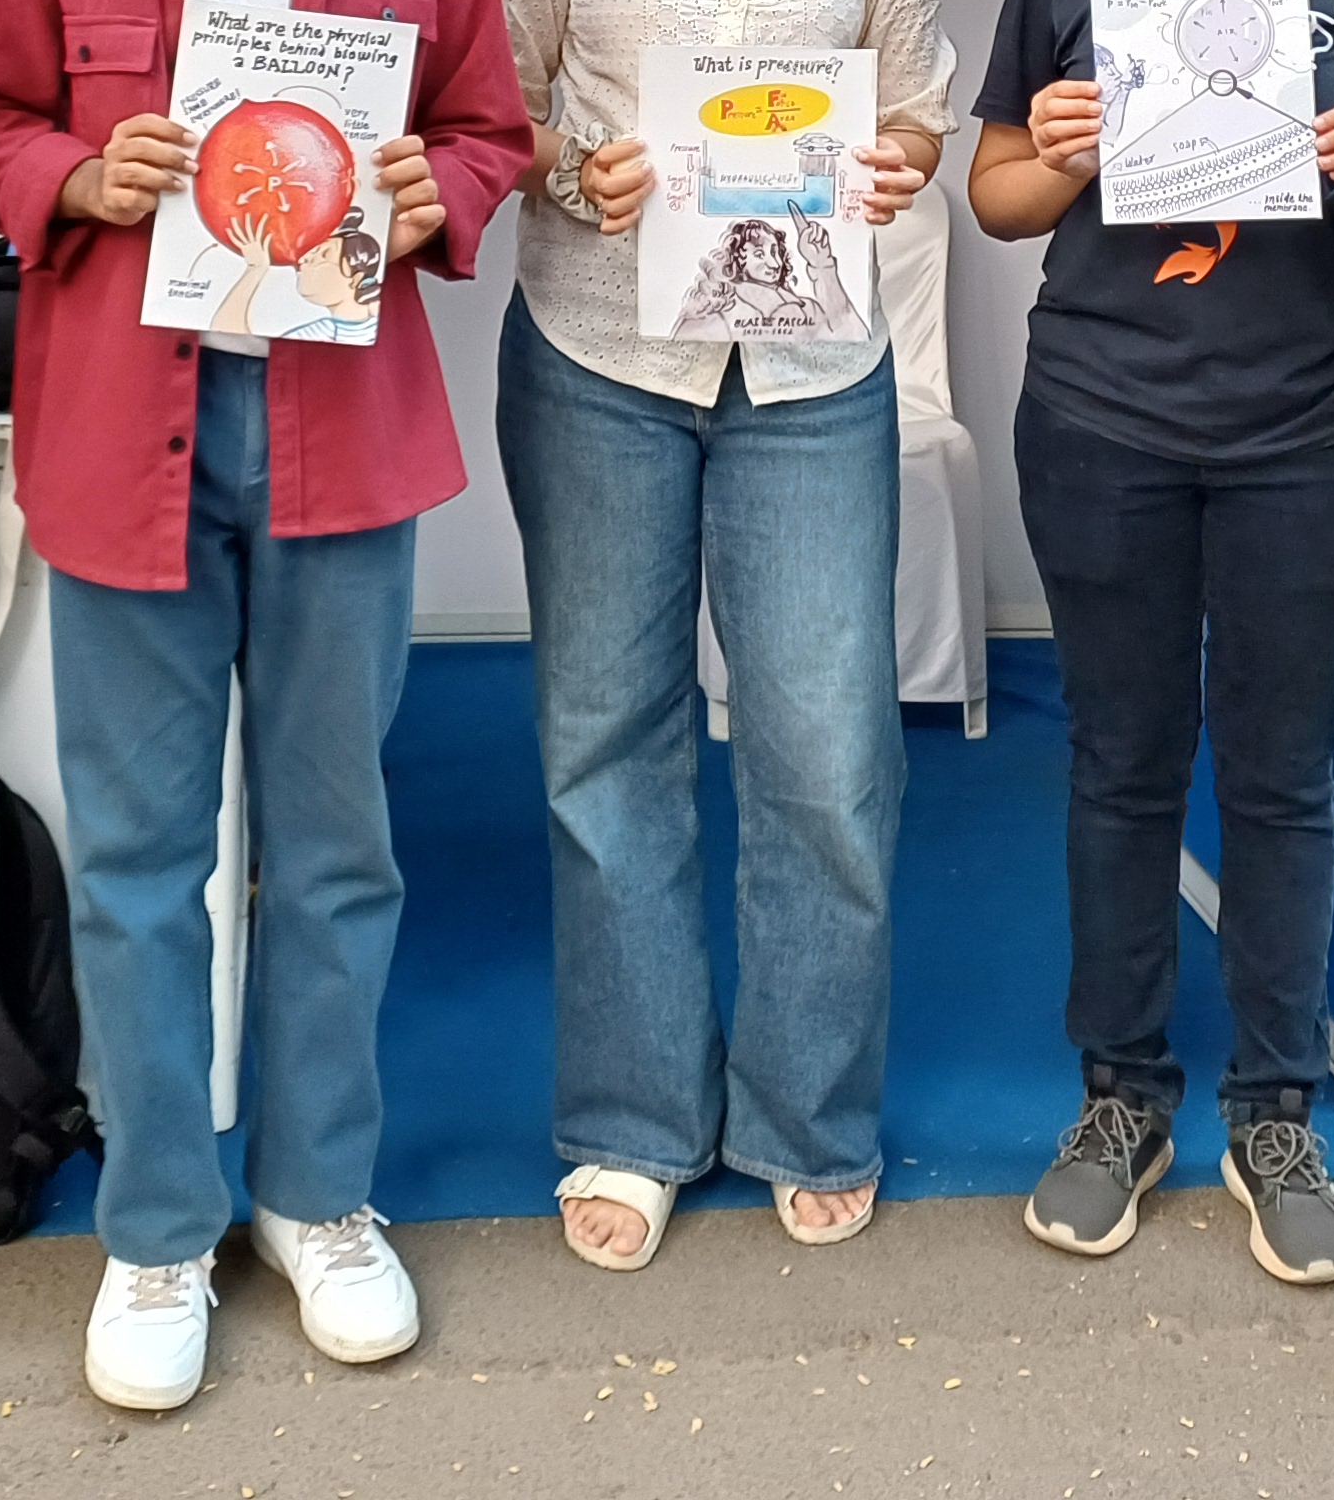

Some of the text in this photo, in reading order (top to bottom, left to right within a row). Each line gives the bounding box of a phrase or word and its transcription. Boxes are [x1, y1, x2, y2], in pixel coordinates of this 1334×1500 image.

[208, 11, 391, 47] What are the physical
[191, 30, 398, 68] principles behind blowing
[233, 57, 244, 67] a
[693, 56, 843, 84] What is pressure?
[268, 176, 282, 192] P
[1298, 193, 1313, 202] the
